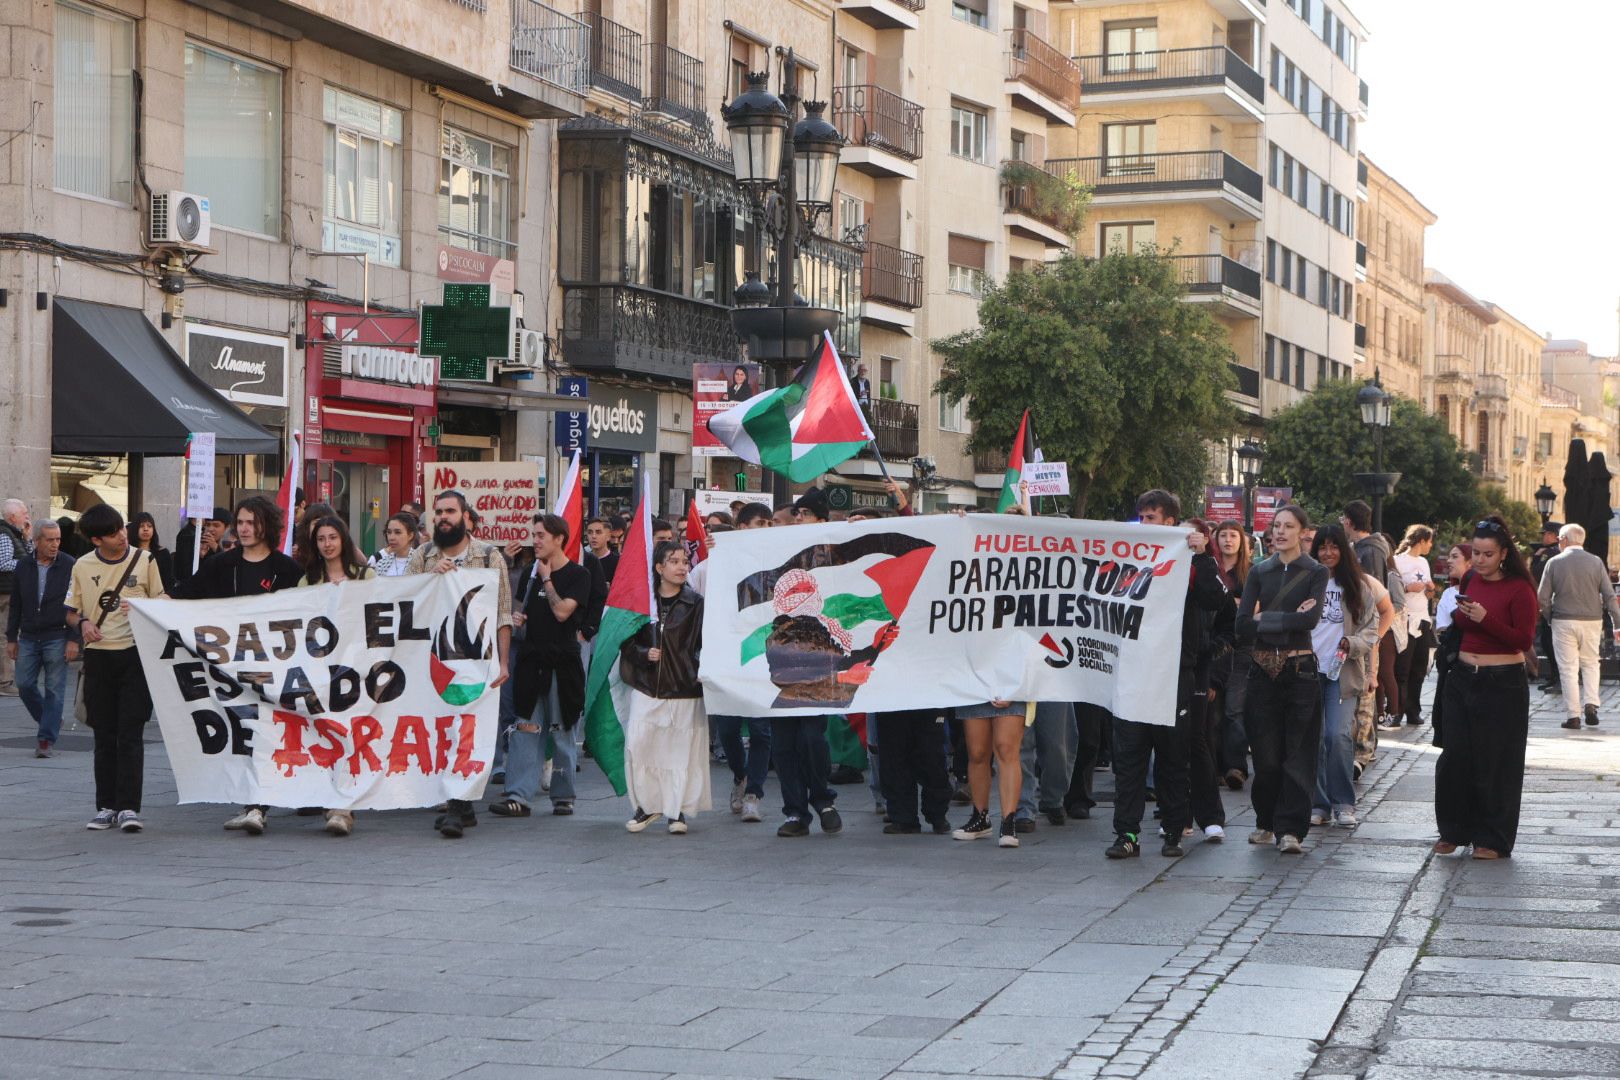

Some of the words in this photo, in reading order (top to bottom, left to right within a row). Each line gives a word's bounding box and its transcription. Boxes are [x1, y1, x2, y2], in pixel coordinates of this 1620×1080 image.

[211, 345, 267, 383] Anamont
[434, 467, 458, 490] NO
[461, 479, 472, 489] es
[474, 479, 498, 489] una
[503, 479, 534, 491] guerra
[476, 495, 537, 511] GENOCIDIO
[496, 512, 531, 526] pueblo
[974, 534, 1078, 554] HUELGA
[1082, 539, 1106, 556] 15
[1111, 541, 1165, 563] OCT
[948, 556, 1077, 594] PARARLO
[1081, 557, 1154, 601] TODO
[159, 616, 340, 665] ABAJO
[364, 600, 432, 650] EL
[929, 597, 986, 634] POR
[992, 593, 1145, 641] PALESTINA
[1078, 647, 1106, 662] JUVENIL
[172, 659, 407, 715] ESTADO
[190, 703, 260, 758] DE
[272, 713, 486, 780] ISRAEL
